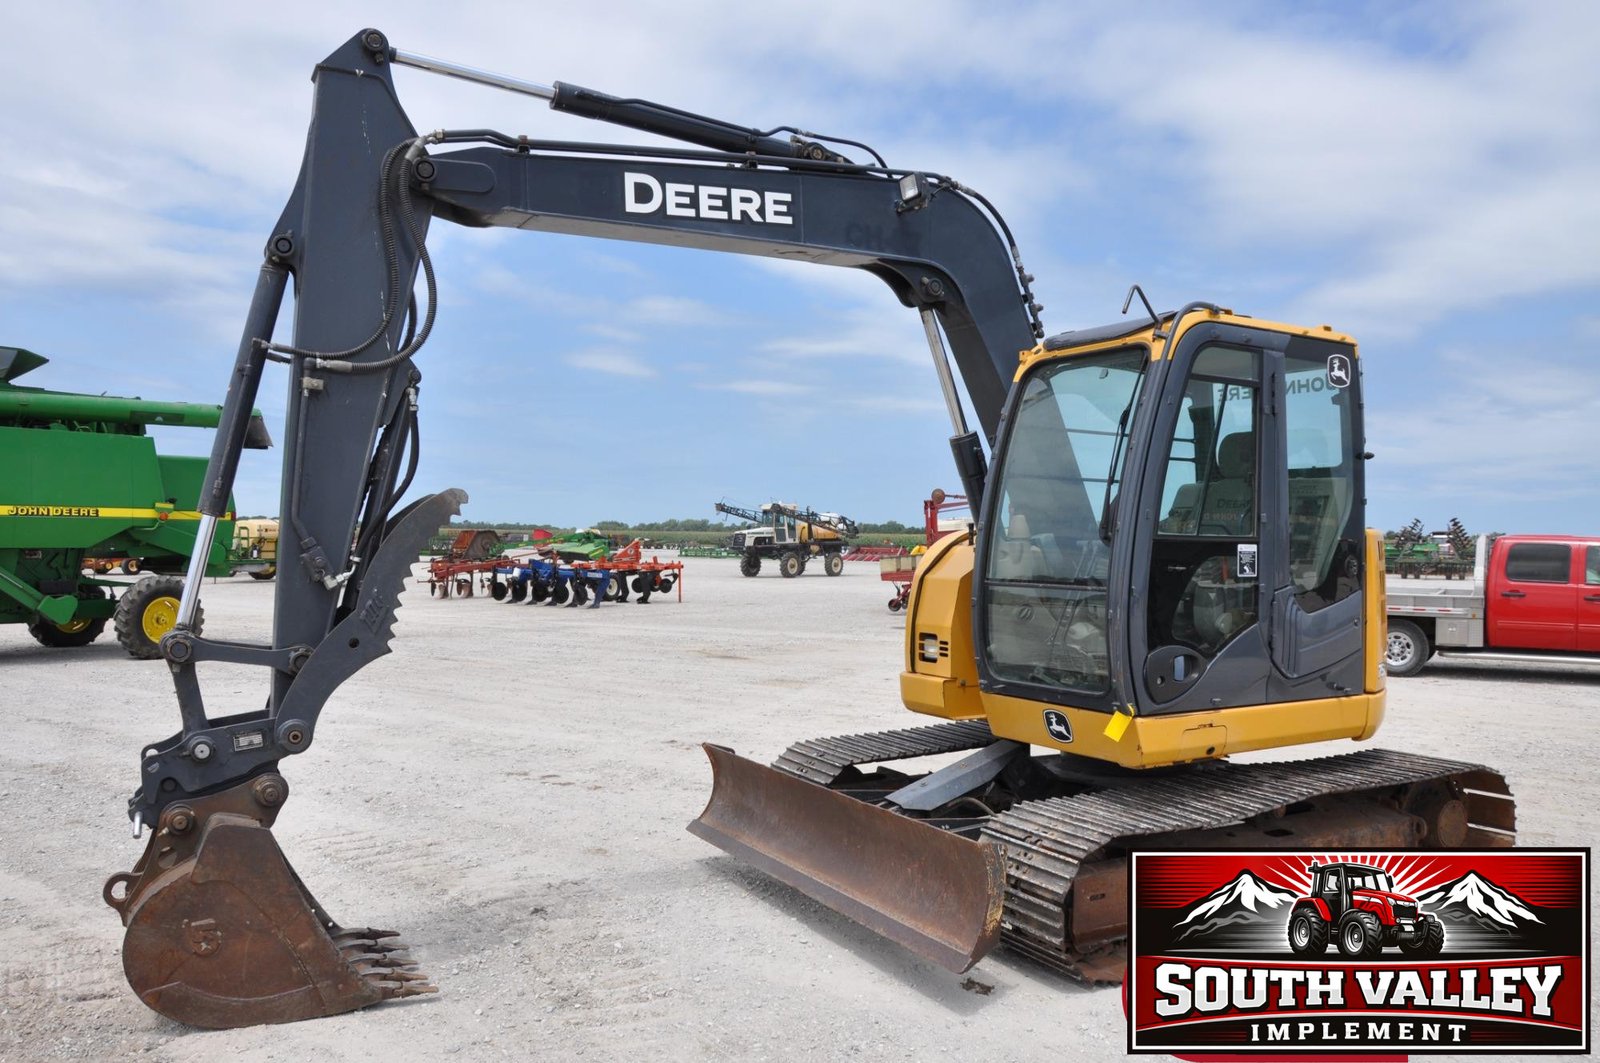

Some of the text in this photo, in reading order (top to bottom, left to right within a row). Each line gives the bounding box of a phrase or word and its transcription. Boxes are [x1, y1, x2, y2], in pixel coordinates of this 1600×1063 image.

[624, 172, 793, 224] DEERE
[8, 506, 98, 517] JOHN DEERE
